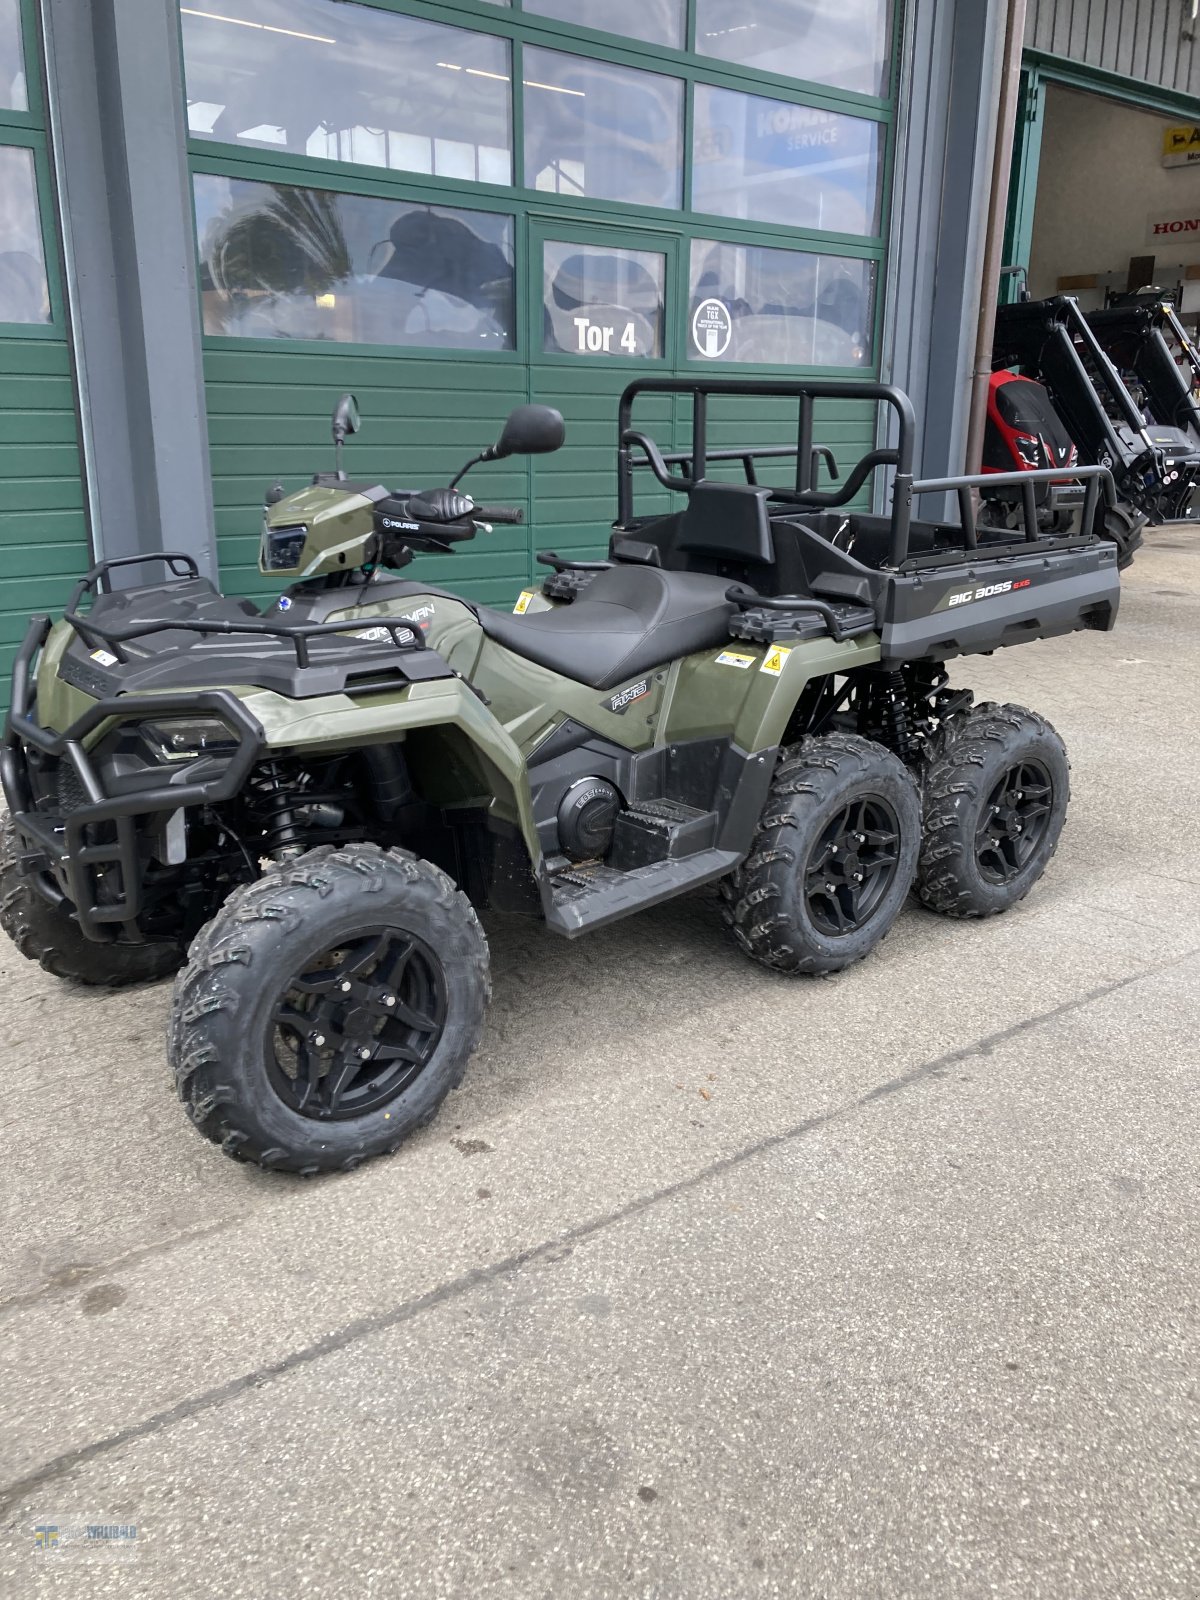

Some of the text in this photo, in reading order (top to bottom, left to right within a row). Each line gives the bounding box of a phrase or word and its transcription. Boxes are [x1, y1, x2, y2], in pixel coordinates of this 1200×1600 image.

[786, 128, 838, 151] SERVICE
[706, 311, 719, 320] TGX
[574, 317, 637, 353] Tor 4
[390, 520, 420, 531] POLARIS
[948, 590, 973, 606] BIG
[974, 580, 1013, 600] BOSS
[612, 684, 646, 710] AWD
